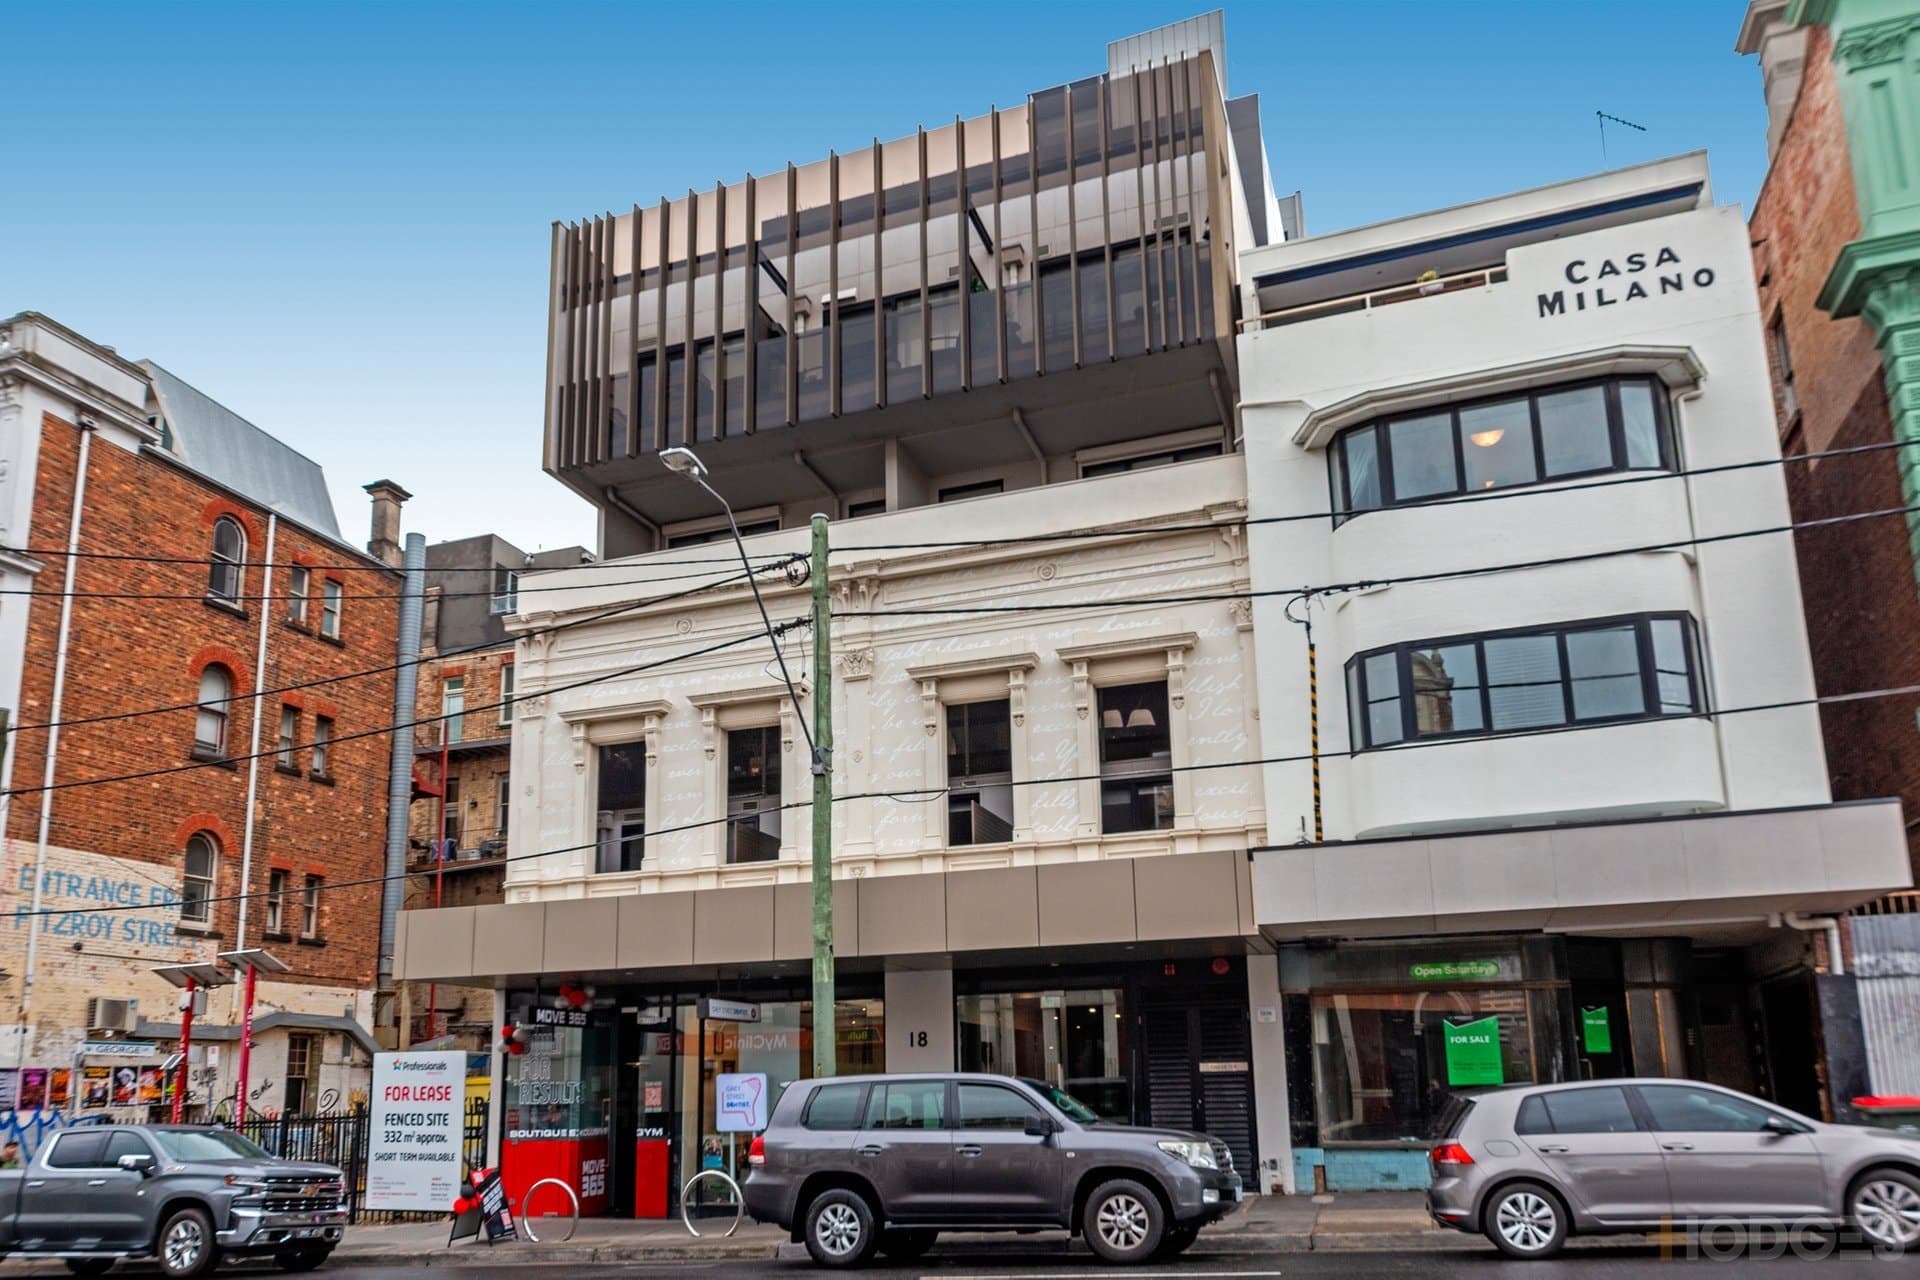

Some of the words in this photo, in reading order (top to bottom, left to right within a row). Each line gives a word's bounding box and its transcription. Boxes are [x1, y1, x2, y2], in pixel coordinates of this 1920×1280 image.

[1565, 247, 1681, 284] CASA
[1537, 268, 1715, 318] MILANO
[14, 905, 116, 940] FTZROY
[1414, 966, 1442, 977] Open
[536, 1009, 566, 1024] MOVE
[568, 1012, 587, 1025] 365
[910, 1031, 928, 1048] 18
[1450, 1036, 1467, 1044] FOR
[1469, 1035, 1490, 1043] SALE
[96, 1045, 141, 1054] GEORGE
[402, 1061, 448, 1071] Professionals
[520, 1057, 551, 1080] FOR
[385, 1086, 410, 1101] FOR
[413, 1085, 452, 1101] LEASE
[384, 1113, 424, 1126] FENCED
[426, 1113, 449, 1126] SITE
[384, 1130, 402, 1143] 332
[416, 1134, 448, 1146] approx.
[509, 1129, 567, 1138] BOUTIQUE
[636, 1128, 664, 1137] GYM
[375, 1152, 397, 1161] SHORT
[400, 1152, 417, 1161] TERM
[418, 1152, 455, 1162] AVAILABLE
[582, 1159, 605, 1175] MOVE
[582, 1174, 605, 1198] 365
